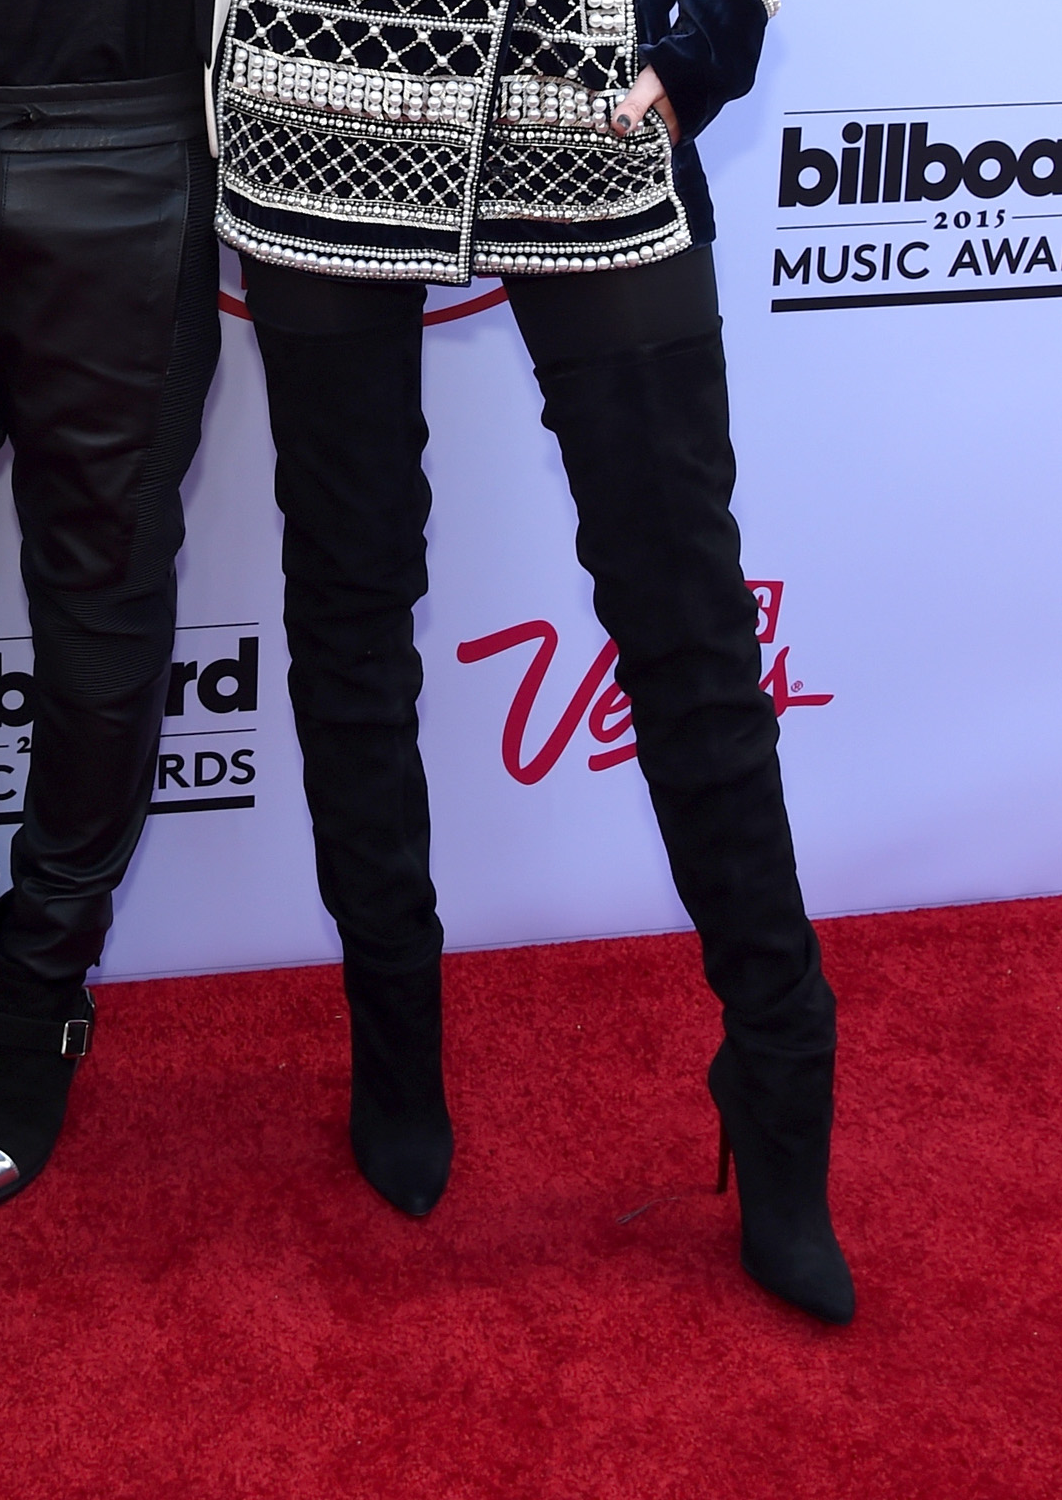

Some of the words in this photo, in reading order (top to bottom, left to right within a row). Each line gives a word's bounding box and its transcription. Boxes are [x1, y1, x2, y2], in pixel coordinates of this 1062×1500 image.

[778, 121, 1062, 207] billboa
[933, 209, 1006, 230] 2015
[772, 241, 930, 286] MUSIC
[947, 236, 1062, 277] AWA
[157, 749, 256, 790] RDS
